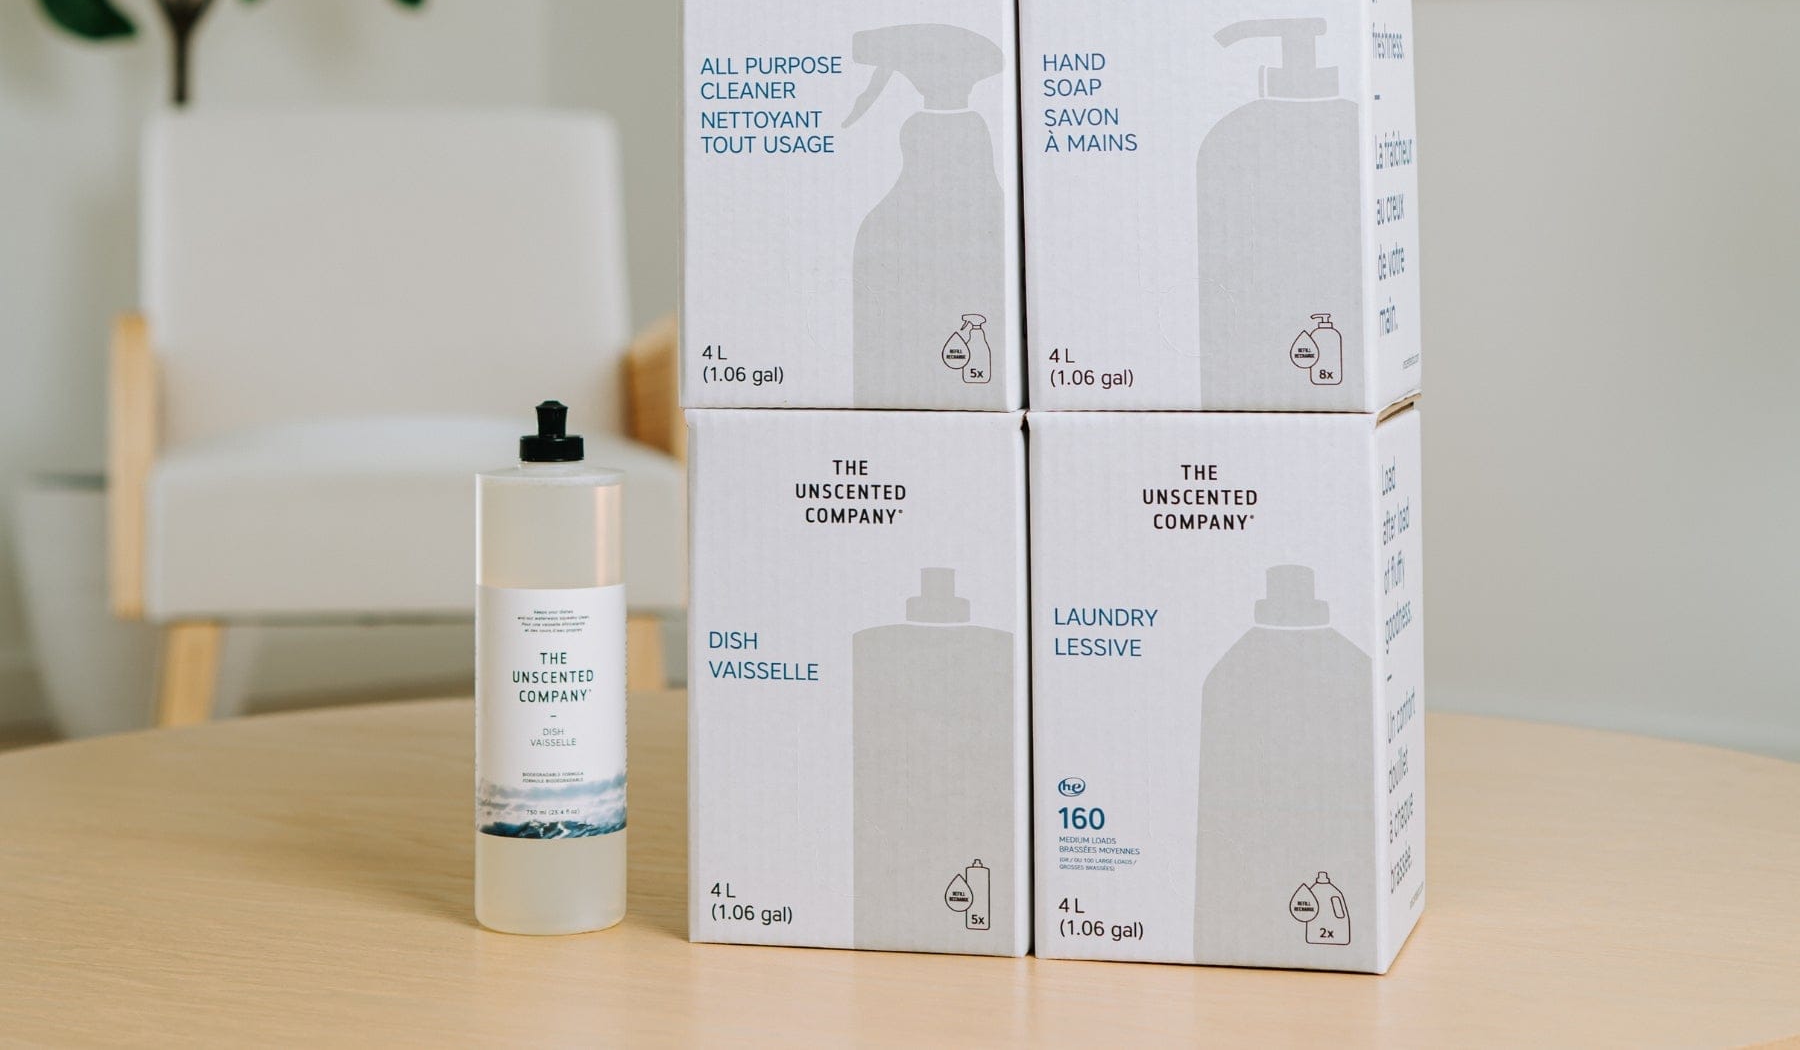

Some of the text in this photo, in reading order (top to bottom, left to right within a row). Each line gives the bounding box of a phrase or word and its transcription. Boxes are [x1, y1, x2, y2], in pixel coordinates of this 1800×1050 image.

[700, 56, 842, 75] ALL PURPOSE
[1043, 53, 1106, 72] HAND
[700, 81, 796, 100] CLEANER
[1043, 79, 1102, 97] SOAP
[701, 111, 823, 129] NETTOYANT
[1044, 108, 1119, 127] SAVON
[701, 135, 835, 154] TOUT USAGE
[1045, 130, 1138, 153] À MAINS
[702, 345, 728, 360] 4 L
[1049, 348, 1075, 363] 4 L
[703, 365, 784, 387] (1.06 gal)
[970, 368, 984, 378] 5x
[1050, 369, 1134, 390] (1.06 gal)
[1319, 369, 1334, 380] 8x
[832, 460, 868, 476] THE
[1181, 464, 1219, 481] THE
[795, 483, 906, 500] UNSCENTED
[1143, 489, 1258, 506] UNSCENTED
[1054, 608, 1158, 627] LAUNDRY
[709, 632, 758, 650] DISH
[1055, 638, 1142, 656] LESSIVE
[540, 652, 567, 665] THE
[512, 669, 594, 684] UNSCENTED
[709, 661, 819, 681] VAISSELLE
[543, 728, 564, 736] DISH
[530, 738, 576, 747] VAISSELLE
[1058, 807, 1105, 830] 160
[1091, 837, 1117, 845] LOADS
[1059, 845, 1140, 855] BRASSÉES MOYENNES
[711, 882, 736, 898] 4 L
[712, 903, 792, 925] (1.06 gal)
[1058, 898, 1085, 914] 4 L
[971, 914, 985, 925] 5x
[1060, 919, 1144, 942] (1.06 gal)
[1319, 927, 1334, 938] 2x
